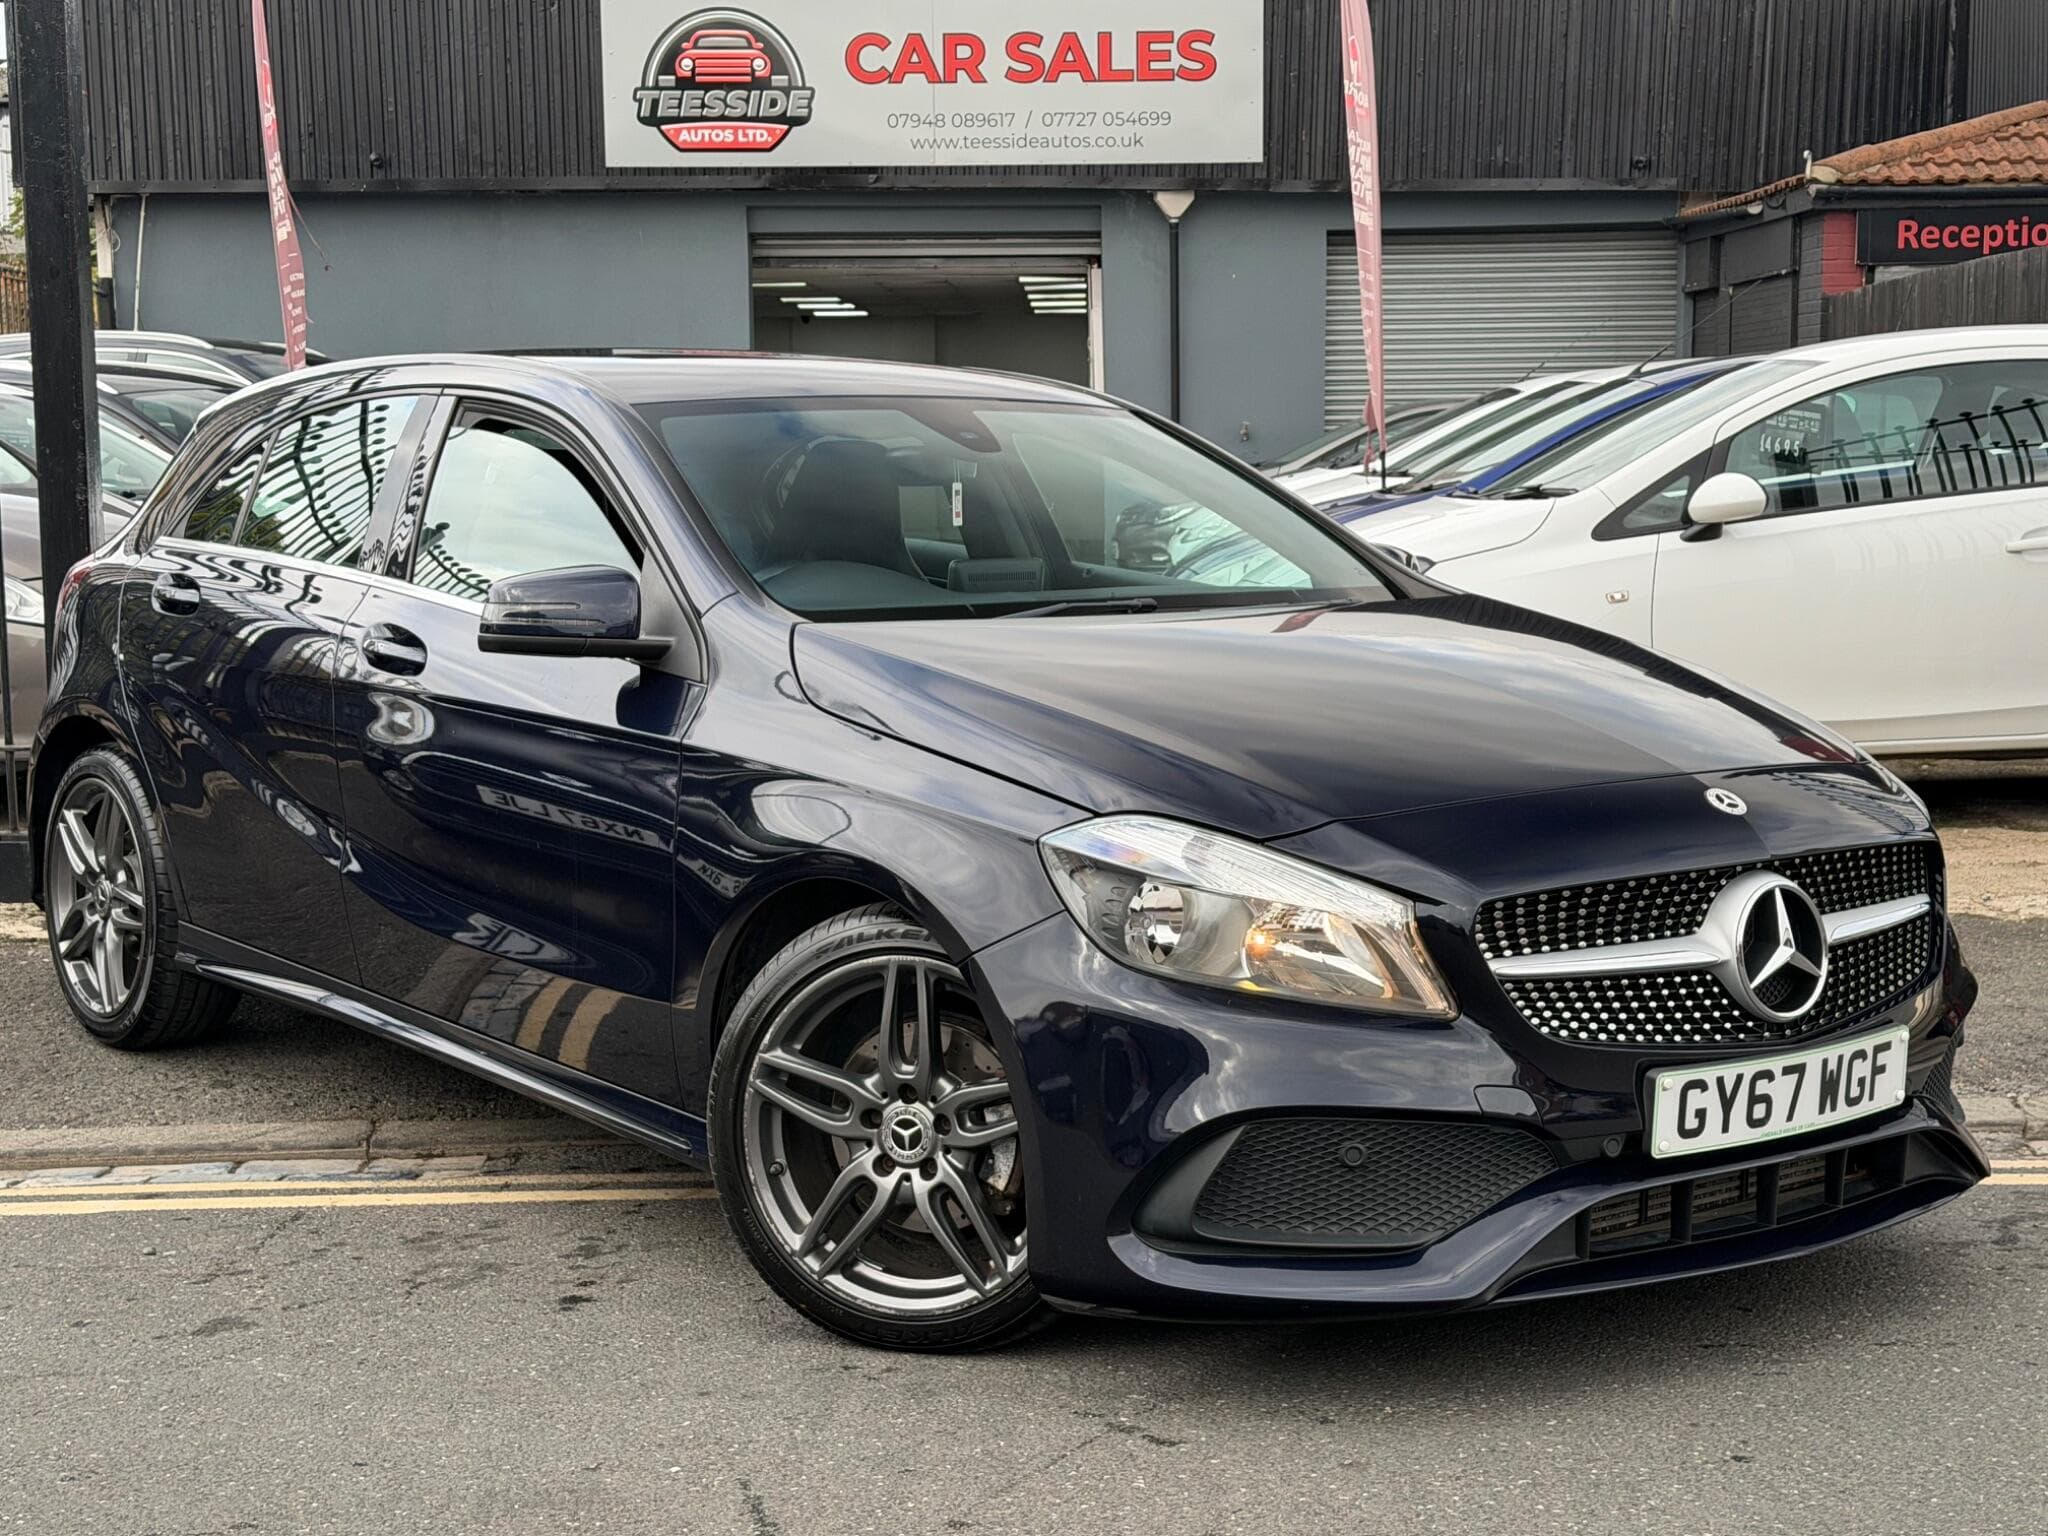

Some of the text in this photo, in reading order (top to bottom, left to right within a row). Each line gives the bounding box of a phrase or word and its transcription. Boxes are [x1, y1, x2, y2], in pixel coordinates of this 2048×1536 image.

[844, 29, 1217, 84] CAR SALES
[635, 89, 813, 118] TEESSIDE
[887, 113, 946, 129] 07948
[951, 112, 1016, 128] 089617
[1042, 111, 1097, 128] 07727
[1103, 110, 1171, 127] 054699
[678, 128, 773, 143] AUTOS LTD.
[910, 132, 1144, 150] www.teessideautos.co.uk
[1677, 1040, 1892, 1140] GY67 WGF
